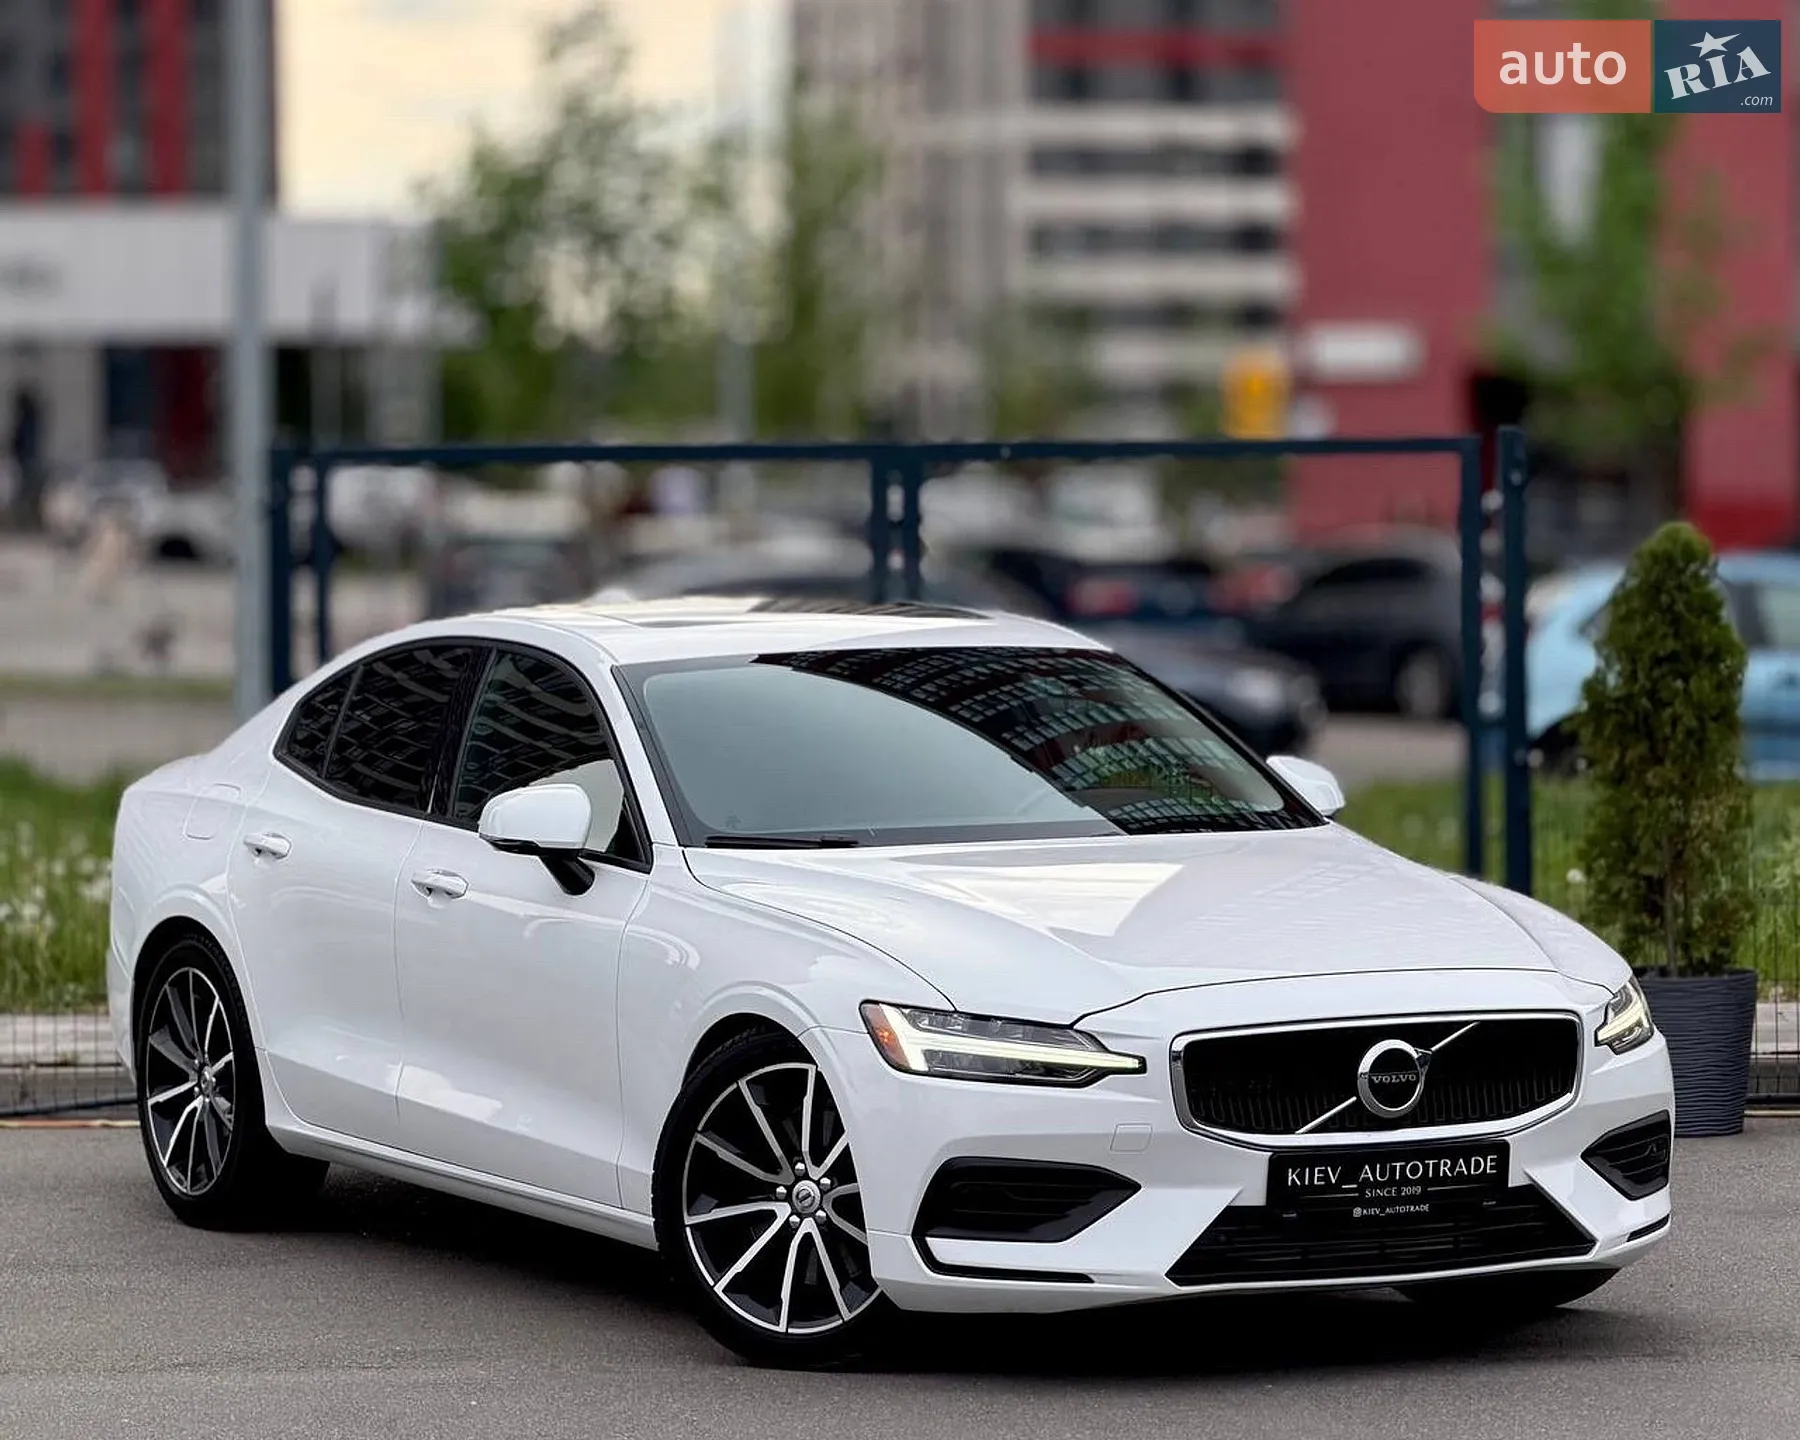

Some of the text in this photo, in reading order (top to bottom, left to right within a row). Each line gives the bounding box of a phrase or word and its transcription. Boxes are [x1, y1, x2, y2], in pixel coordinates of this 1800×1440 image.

[1371, 1074, 1417, 1084] VOLVO
[1287, 1155, 1498, 1189] KIEV_AUTOTRADE
[1365, 1186, 1421, 1198] SINCE 2019
[1363, 1204, 1430, 1216] KIEV_AUTOTRADE
